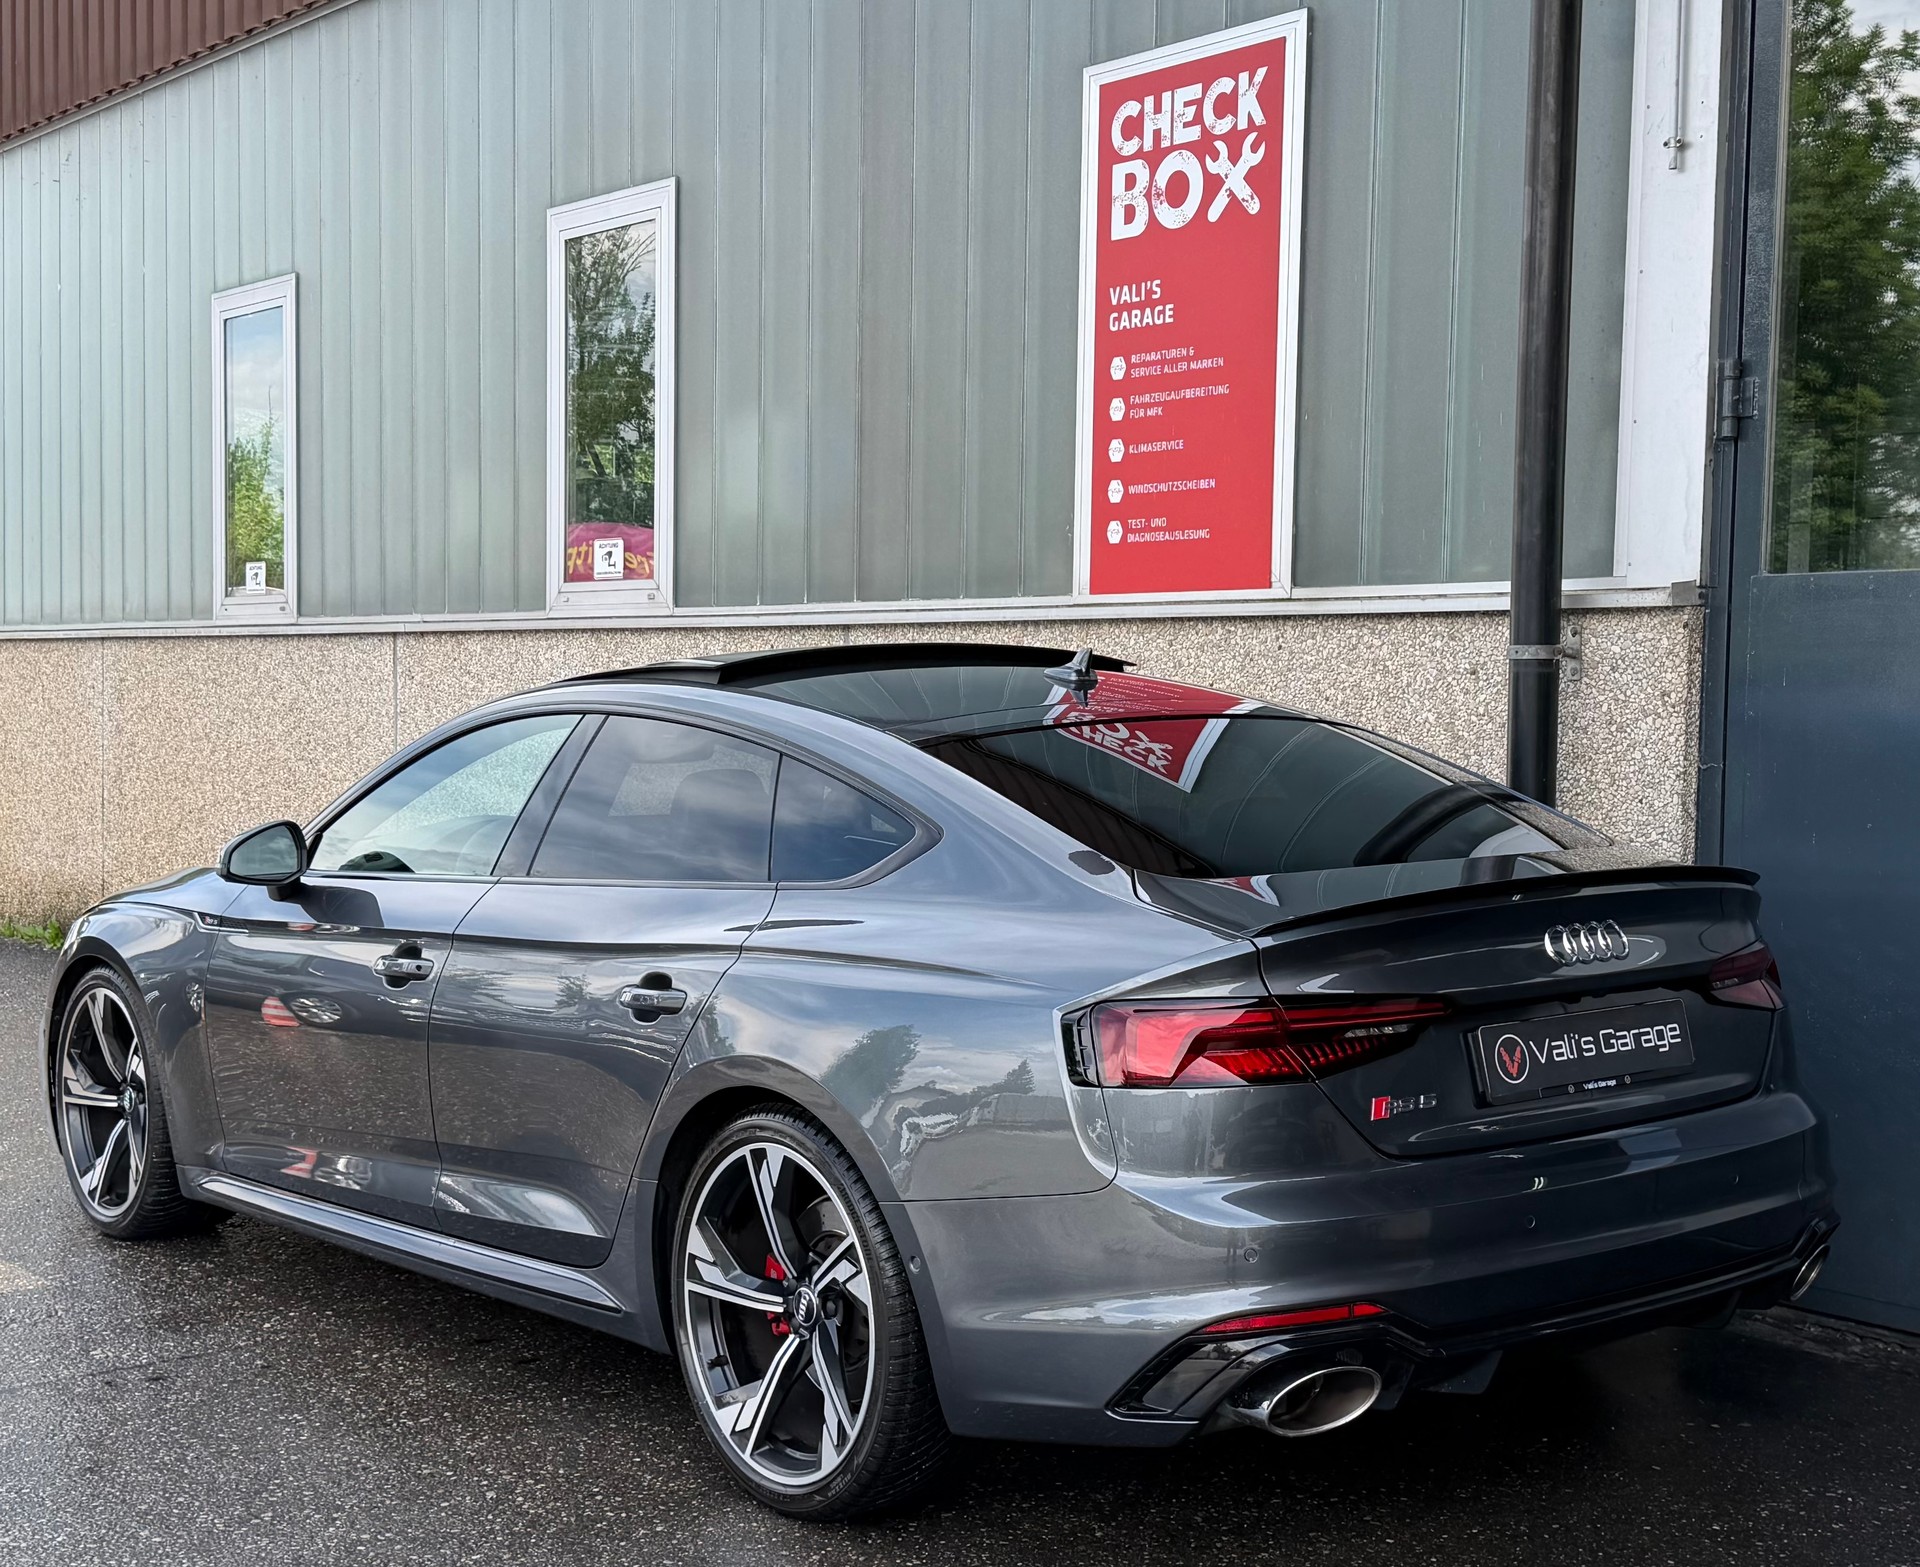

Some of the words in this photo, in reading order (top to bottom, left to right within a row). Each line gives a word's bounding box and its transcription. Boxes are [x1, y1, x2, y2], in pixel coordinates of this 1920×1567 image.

[1111, 66, 1269, 156] CHECK
[1111, 131, 1266, 241] BOX
[1109, 279, 1161, 306] VALI'S
[1109, 303, 1174, 332] GARAGE
[1131, 347, 1187, 364] REPARATUREN
[1189, 346, 1195, 356] &
[1130, 365, 1162, 379] SERVICE
[1163, 362, 1188, 374] ALLER
[1190, 357, 1224, 370] MARKEN
[1130, 384, 1230, 405] FAHRZEUGAUFBEREITUNG
[1129, 407, 1145, 419] FÜR
[1146, 407, 1163, 417] MFK
[1129, 440, 1184, 454] KLIMASERVICE
[1128, 478, 1216, 495] WINDSCHUTZSCHEIBEN
[1128, 519, 1148, 529] TEST-
[1150, 517, 1167, 528] UND
[1127, 529, 1210, 543] DIAGNOSEAUSLESUNG
[1529, 1033, 1596, 1064] Vali's
[1600, 1023, 1682, 1054] Garage
